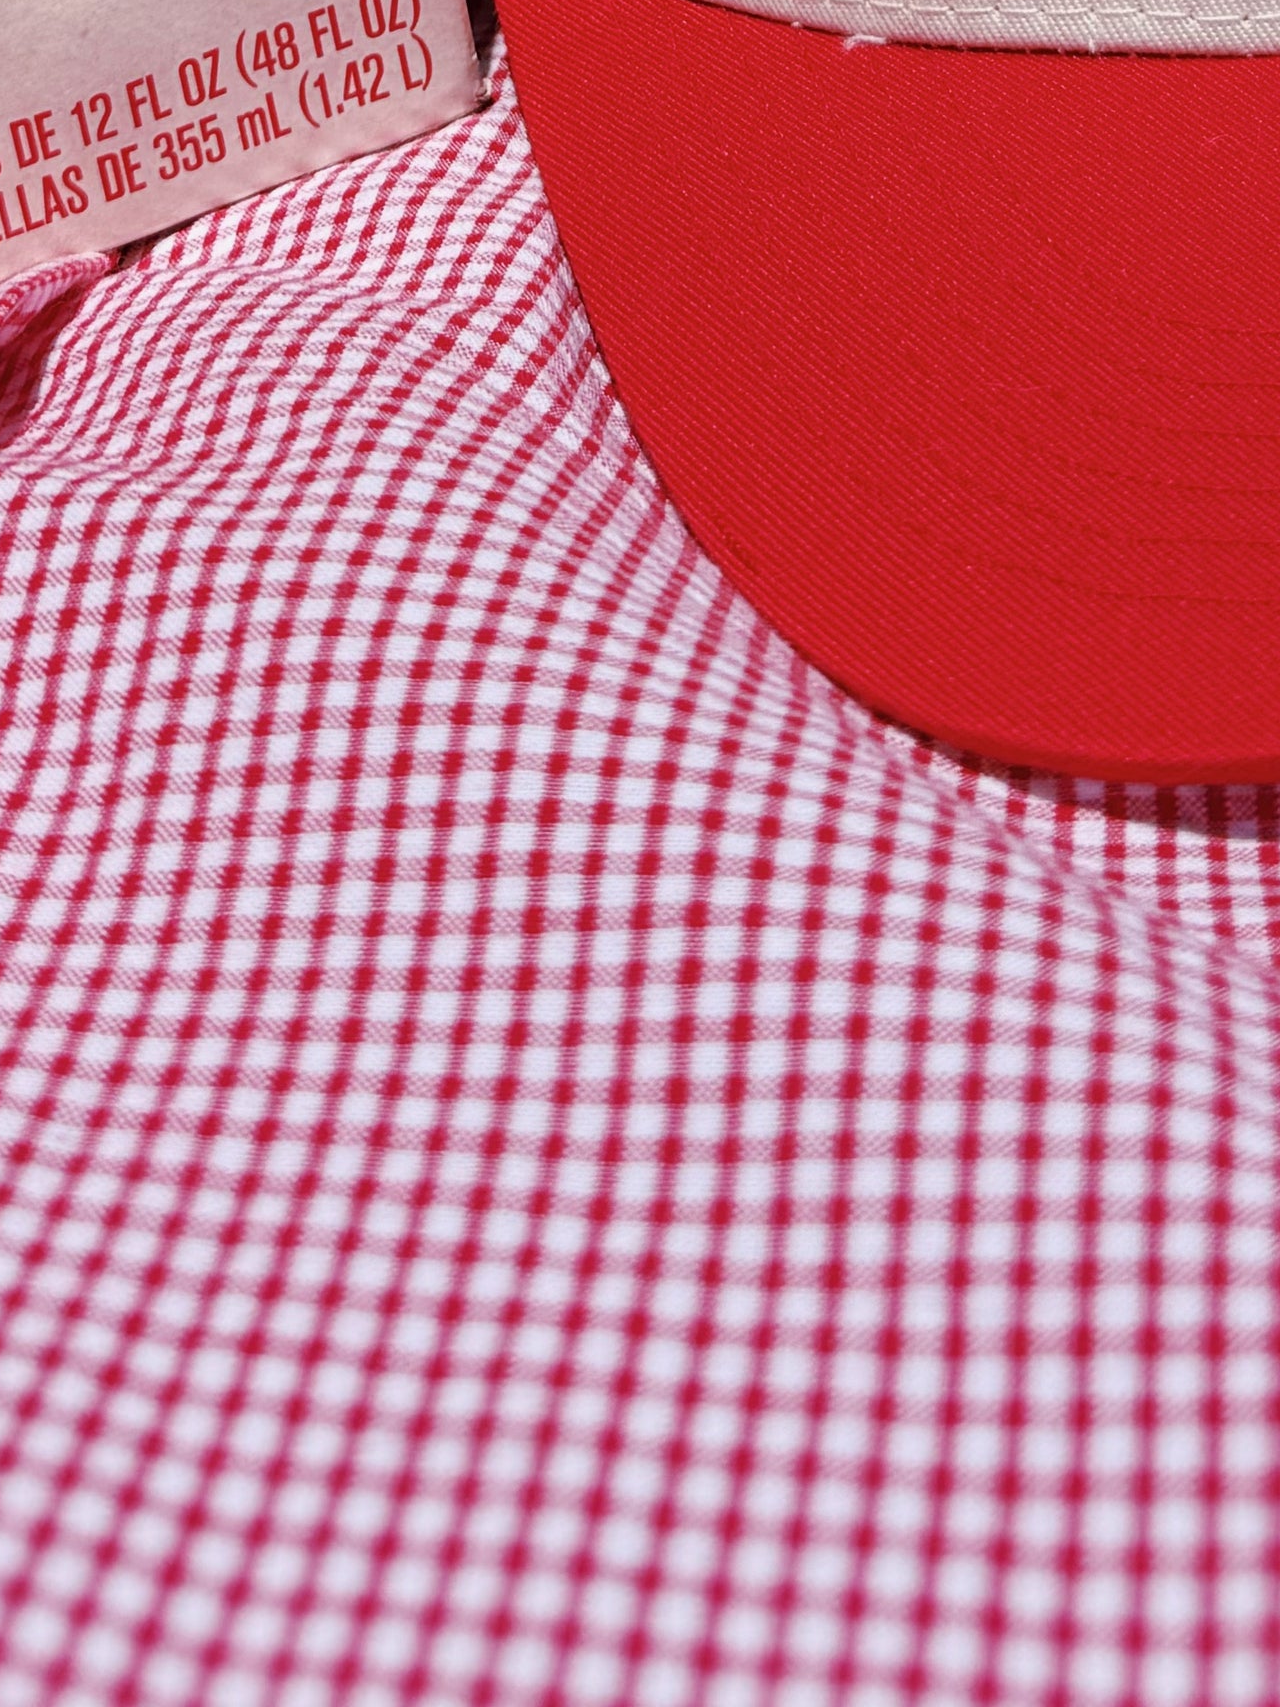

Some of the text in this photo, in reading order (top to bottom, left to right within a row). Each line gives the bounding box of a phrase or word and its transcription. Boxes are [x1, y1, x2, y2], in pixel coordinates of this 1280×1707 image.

[9, 110, 61, 168] DE
[70, 93, 118, 150] 12
[126, 70, 173, 129] FL
[179, 47, 228, 109] OZ
[235, 22, 299, 88] (48
[308, 4, 352, 59] FL
[98, 145, 147, 203] DE
[152, 114, 224, 182] 355
[238, 92, 292, 151] mL
[298, 54, 389, 129] (1.42
[395, 32, 433, 91] L)
